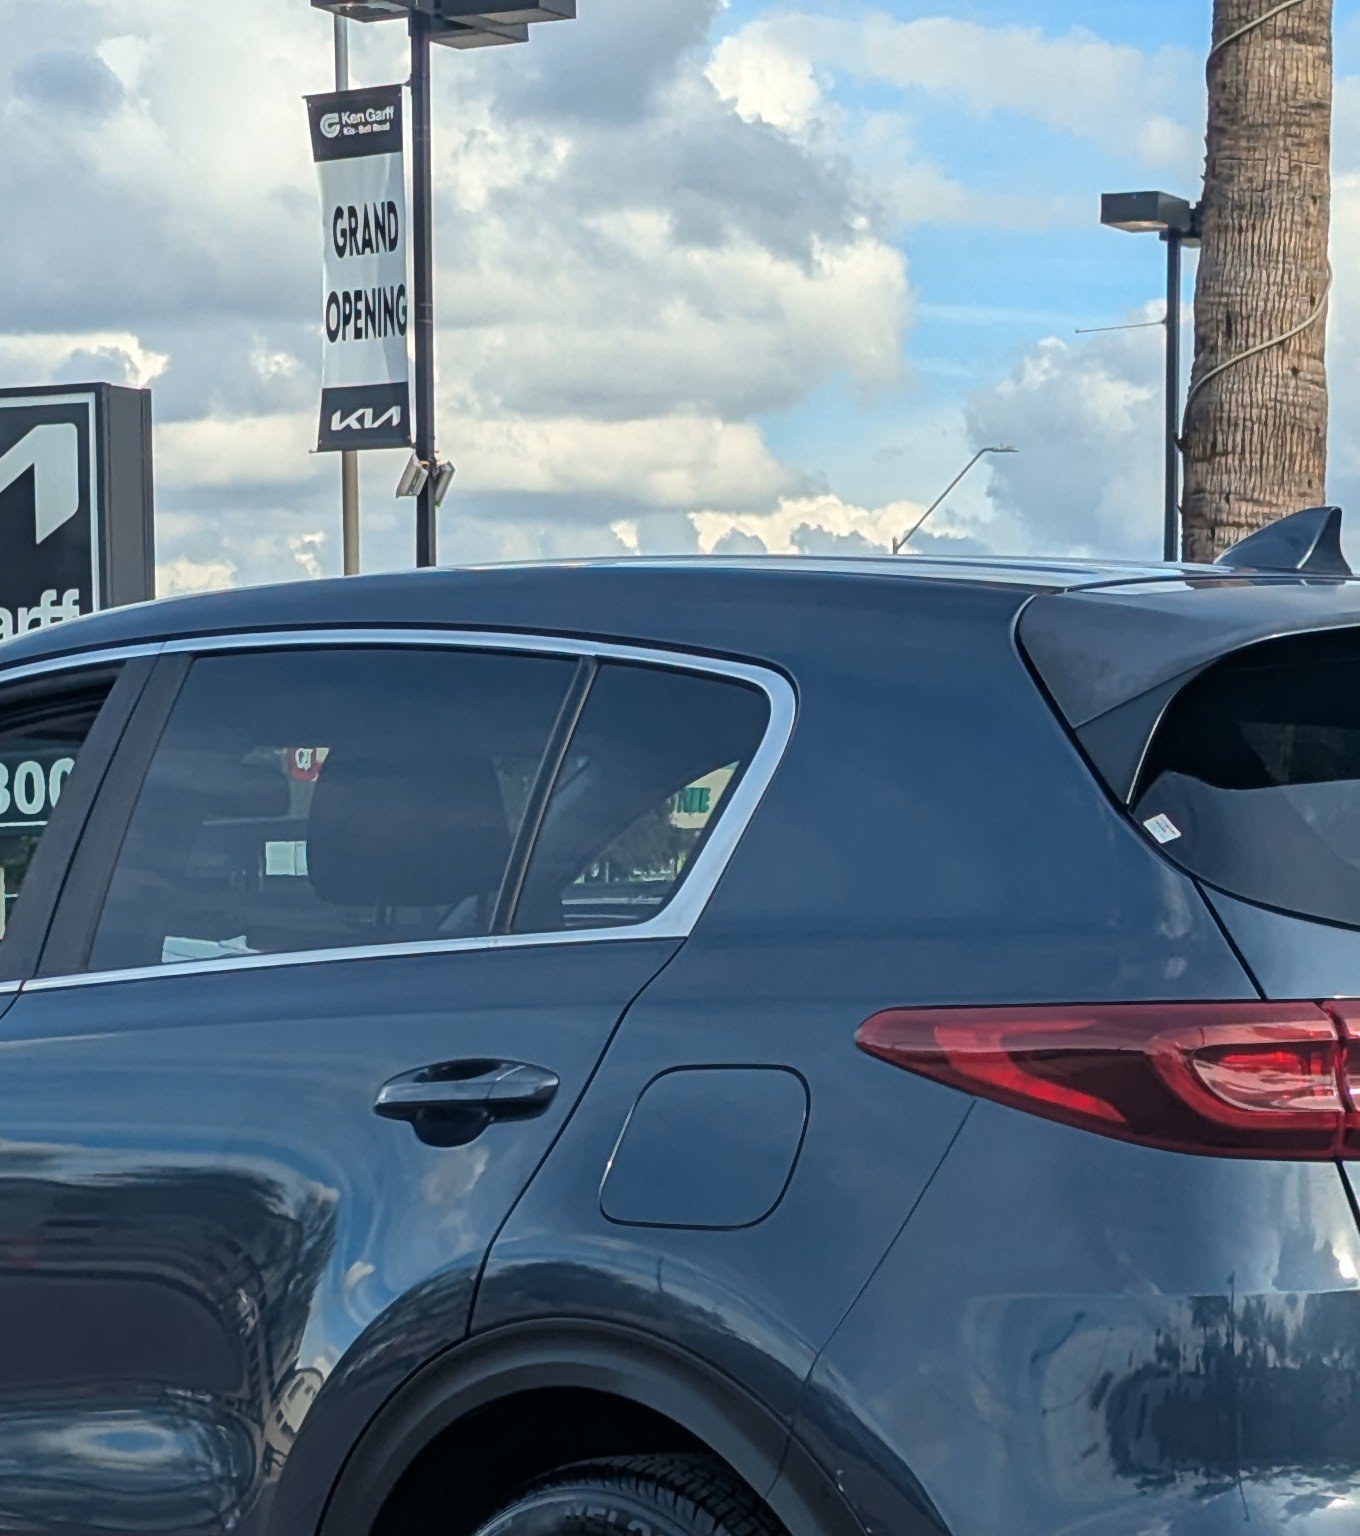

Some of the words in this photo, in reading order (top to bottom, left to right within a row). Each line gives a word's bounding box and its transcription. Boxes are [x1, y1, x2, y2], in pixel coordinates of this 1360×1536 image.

[341, 111, 365, 124] Ken
[366, 105, 394, 122] Garff
[332, 200, 399, 258] GRAND
[325, 283, 407, 343] OPENING
